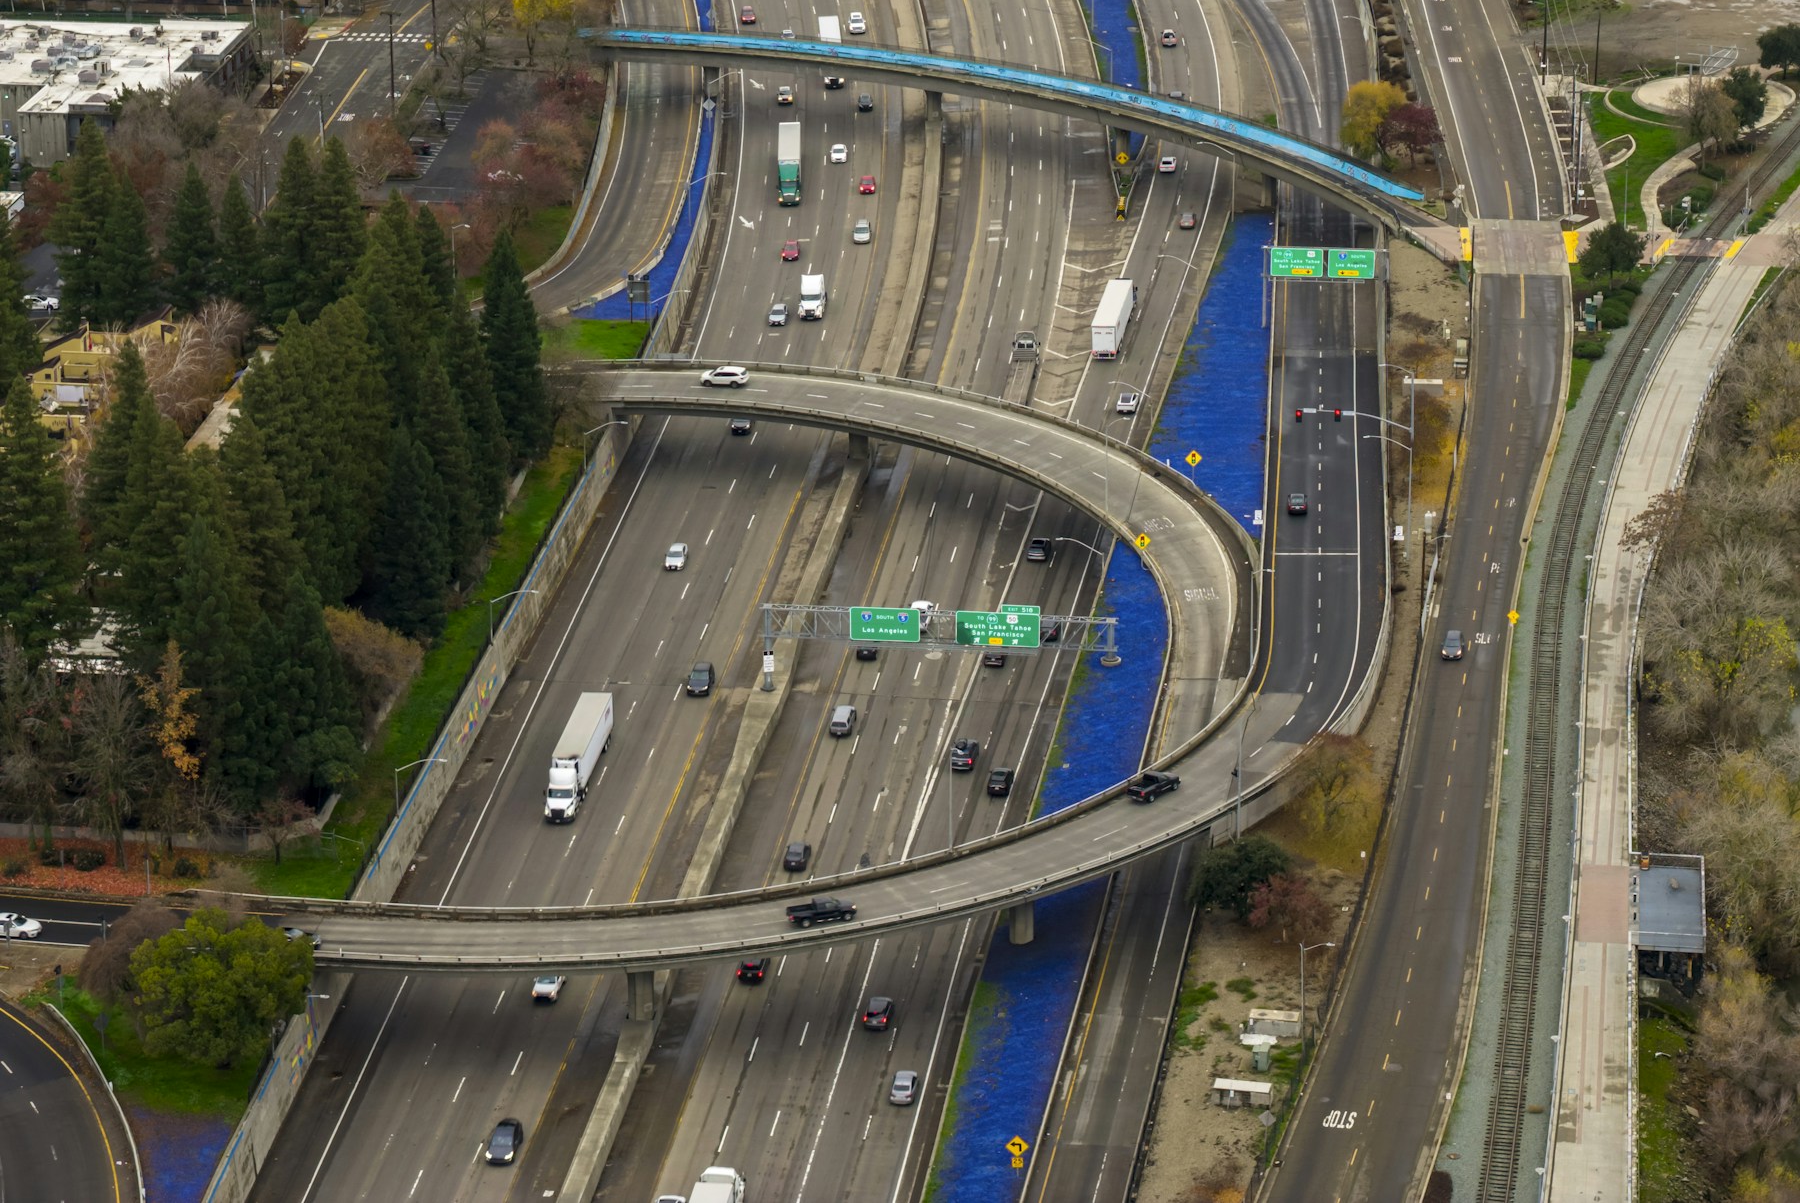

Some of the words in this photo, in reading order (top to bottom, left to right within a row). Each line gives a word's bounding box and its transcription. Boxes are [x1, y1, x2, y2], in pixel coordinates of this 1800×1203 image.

[337, 113, 355, 121] XING
[879, 627, 908, 635] Angeles
[988, 630, 1024, 638] Francisco
[1322, 1110, 1357, 1129] STOP
